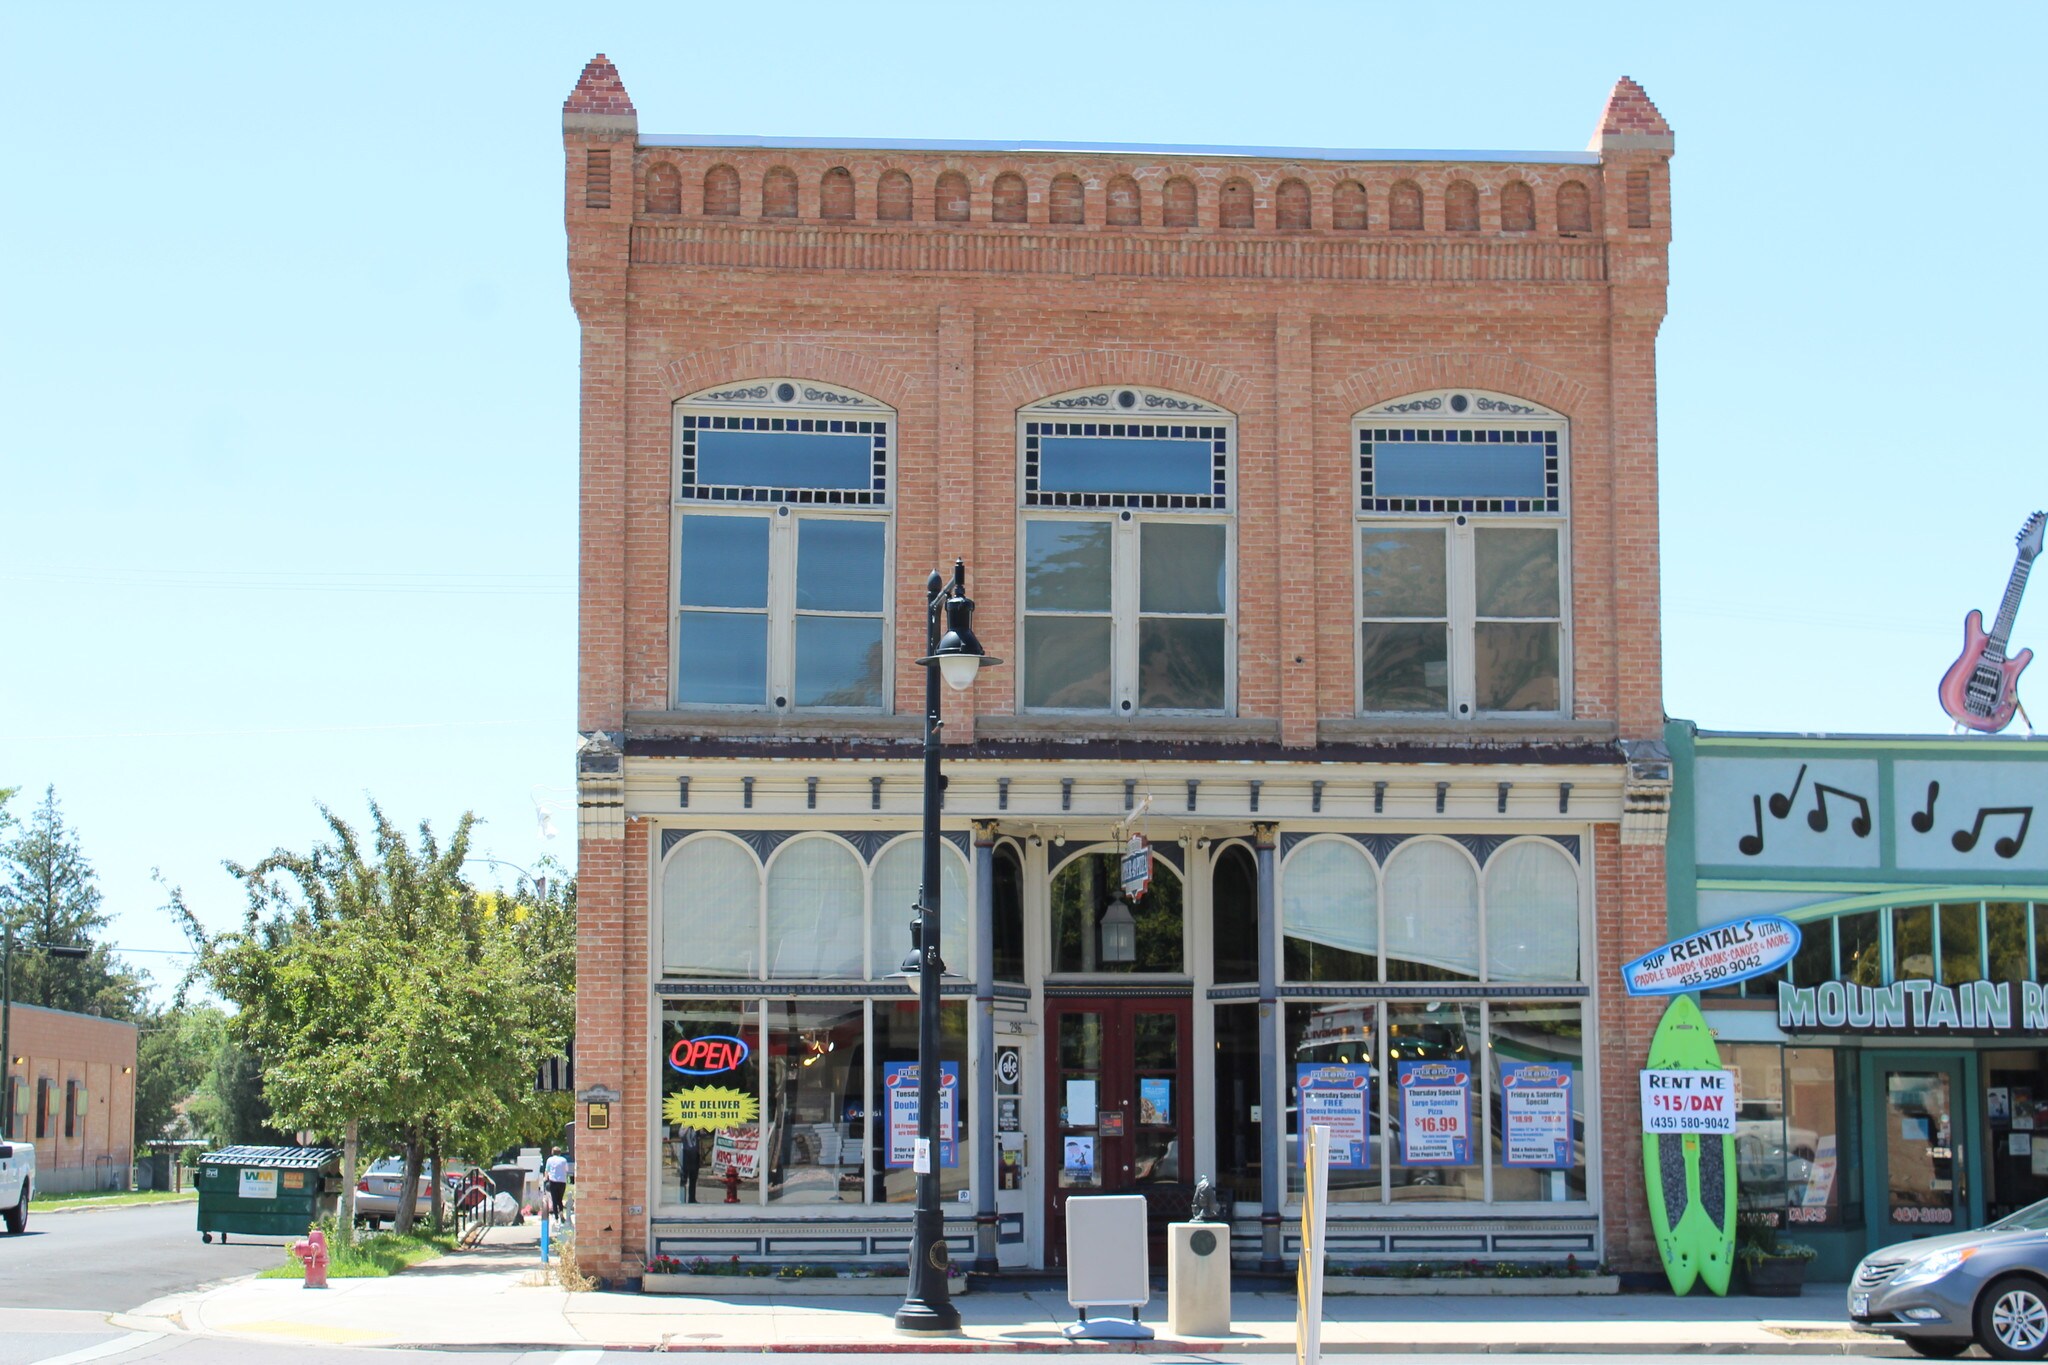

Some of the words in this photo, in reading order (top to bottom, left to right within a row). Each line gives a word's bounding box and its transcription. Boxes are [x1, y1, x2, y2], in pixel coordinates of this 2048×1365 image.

[1643, 955, 1665, 970] SUP
[1669, 921, 1754, 962] RENTALS
[1758, 922, 1782, 937] UTAH
[1634, 970, 1664, 988] PADDLE
[1667, 960, 1696, 978] BOARDS
[1699, 952, 1728, 969] KAYAKS
[1730, 943, 1759, 960] CANOES
[1766, 933, 1790, 949] MORE
[1778, 980, 2011, 1028] MOUNTAIN
[2022, 981, 2048, 1028] R
[1009, 1022, 1022, 1033] 296
[671, 1039, 742, 1070] OPEN
[1649, 1074, 1695, 1089] RENT
[1700, 1076, 1726, 1089] ME
[1409, 1089, 1437, 1097] Thursday
[680, 1100, 696, 1109] WE
[700, 1100, 740, 1109] DELIVER
[894, 1101, 919, 1109] Doubl
[1653, 1095, 1724, 1111] $15/DAY
[681, 1111, 739, 1119] 801-491-9111
[1415, 1117, 1457, 1132] $16.99
[1650, 1117, 1677, 1129] (435)
[1681, 1117, 1729, 1129] 580-9042
[245, 1171, 273, 1181] WM
